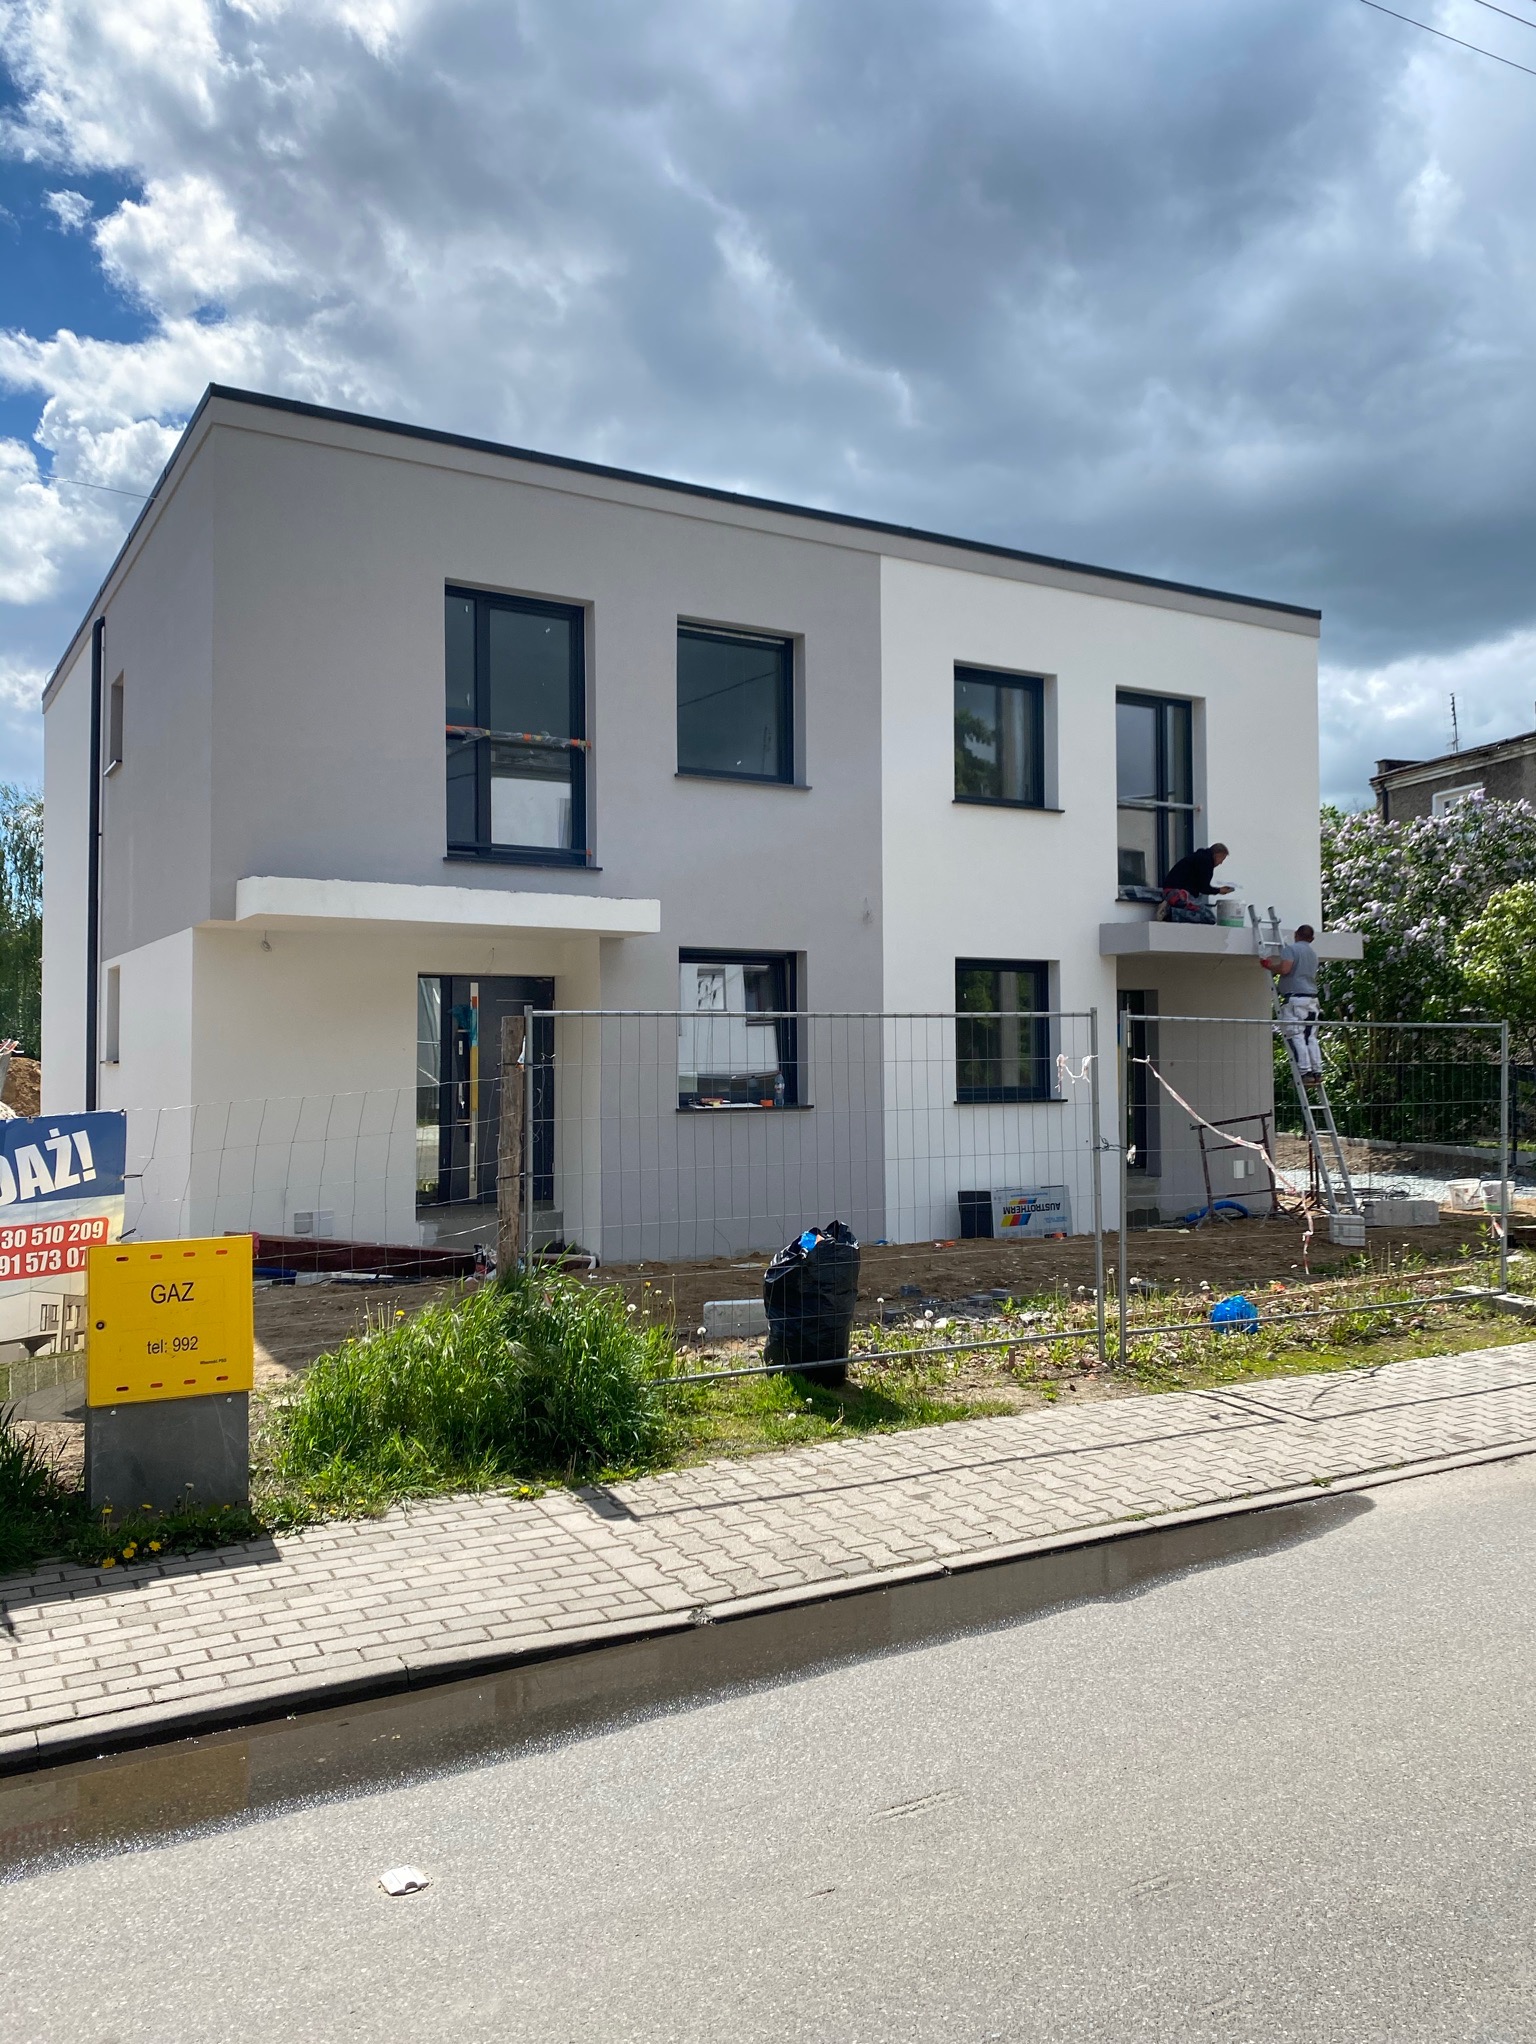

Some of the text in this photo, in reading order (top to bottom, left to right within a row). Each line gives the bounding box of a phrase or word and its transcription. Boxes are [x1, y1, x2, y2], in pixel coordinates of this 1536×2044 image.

[1003, 1202, 1061, 1215] AUSTROTHERM
[31, 1225, 65, 1246] 510
[68, 1221, 104, 1242] 209
[25, 1249, 62, 1273] 573
[150, 1282, 195, 1304] GAZ
[147, 1336, 198, 1354] tel: 992
